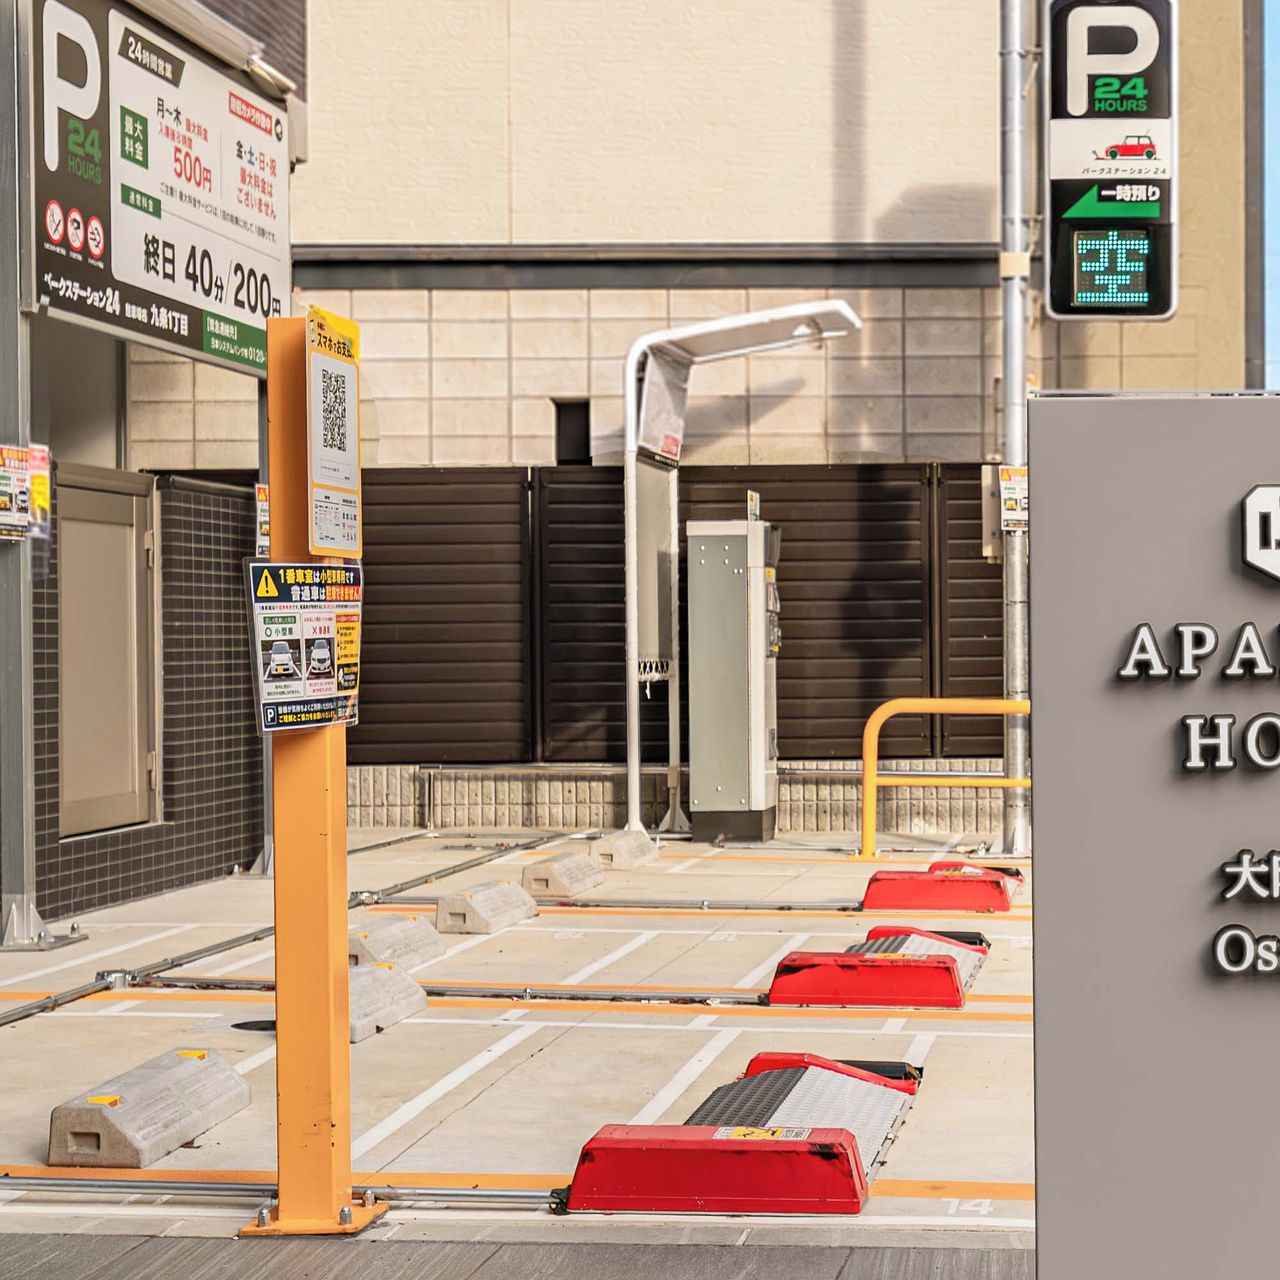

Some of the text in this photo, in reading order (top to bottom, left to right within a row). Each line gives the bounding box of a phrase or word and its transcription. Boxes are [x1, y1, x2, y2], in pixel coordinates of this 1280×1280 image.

[1066, 6, 1160, 116] P
[1094, 77, 1148, 99] 24
[1095, 100, 1148, 112] HOURS
[67, 118, 101, 163] 24
[68, 155, 101, 185] HOURS
[174, 146, 212, 193] 500円
[1101, 184, 1161, 201] 一時預り
[143, 233, 176, 284] 終日
[1077, 231, 1149, 302] 空
